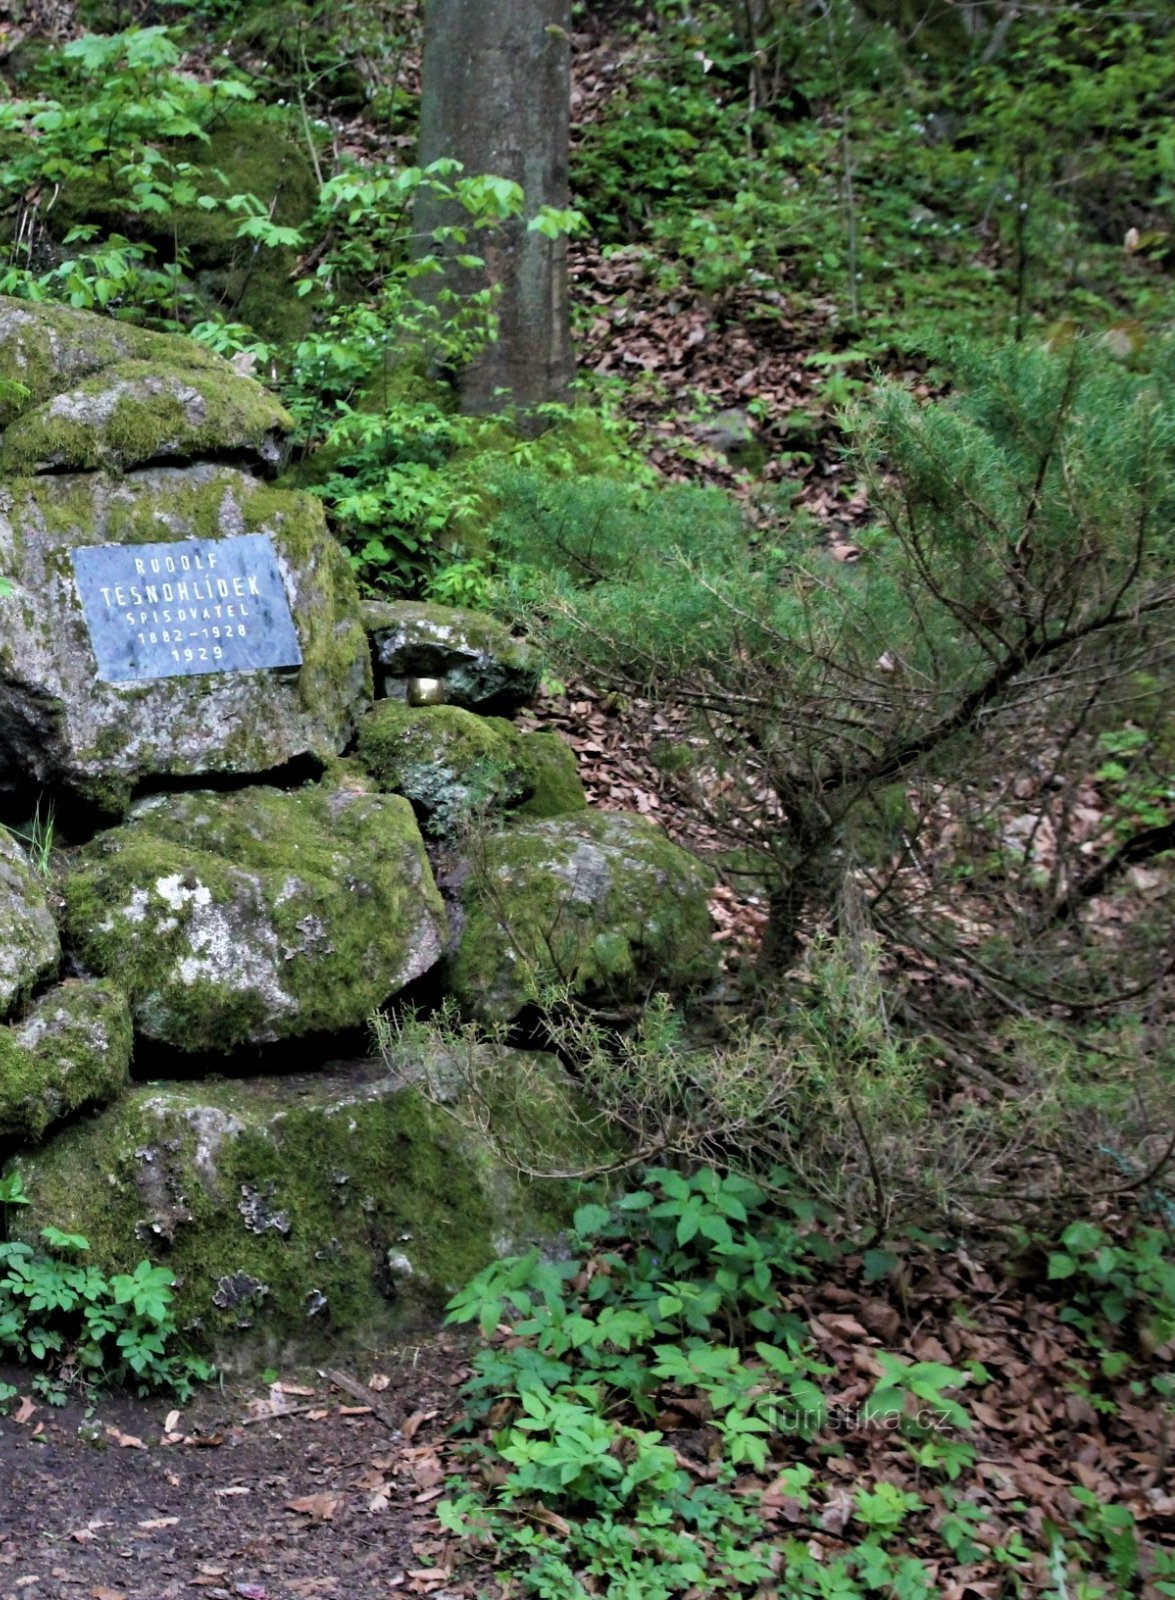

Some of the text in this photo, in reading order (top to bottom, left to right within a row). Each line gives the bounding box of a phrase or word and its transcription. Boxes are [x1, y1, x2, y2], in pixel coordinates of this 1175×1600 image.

[135, 553, 217, 574] RUDOLF
[126, 605, 249, 625] SPISOVATEL
[172, 646, 223, 662] 1929
